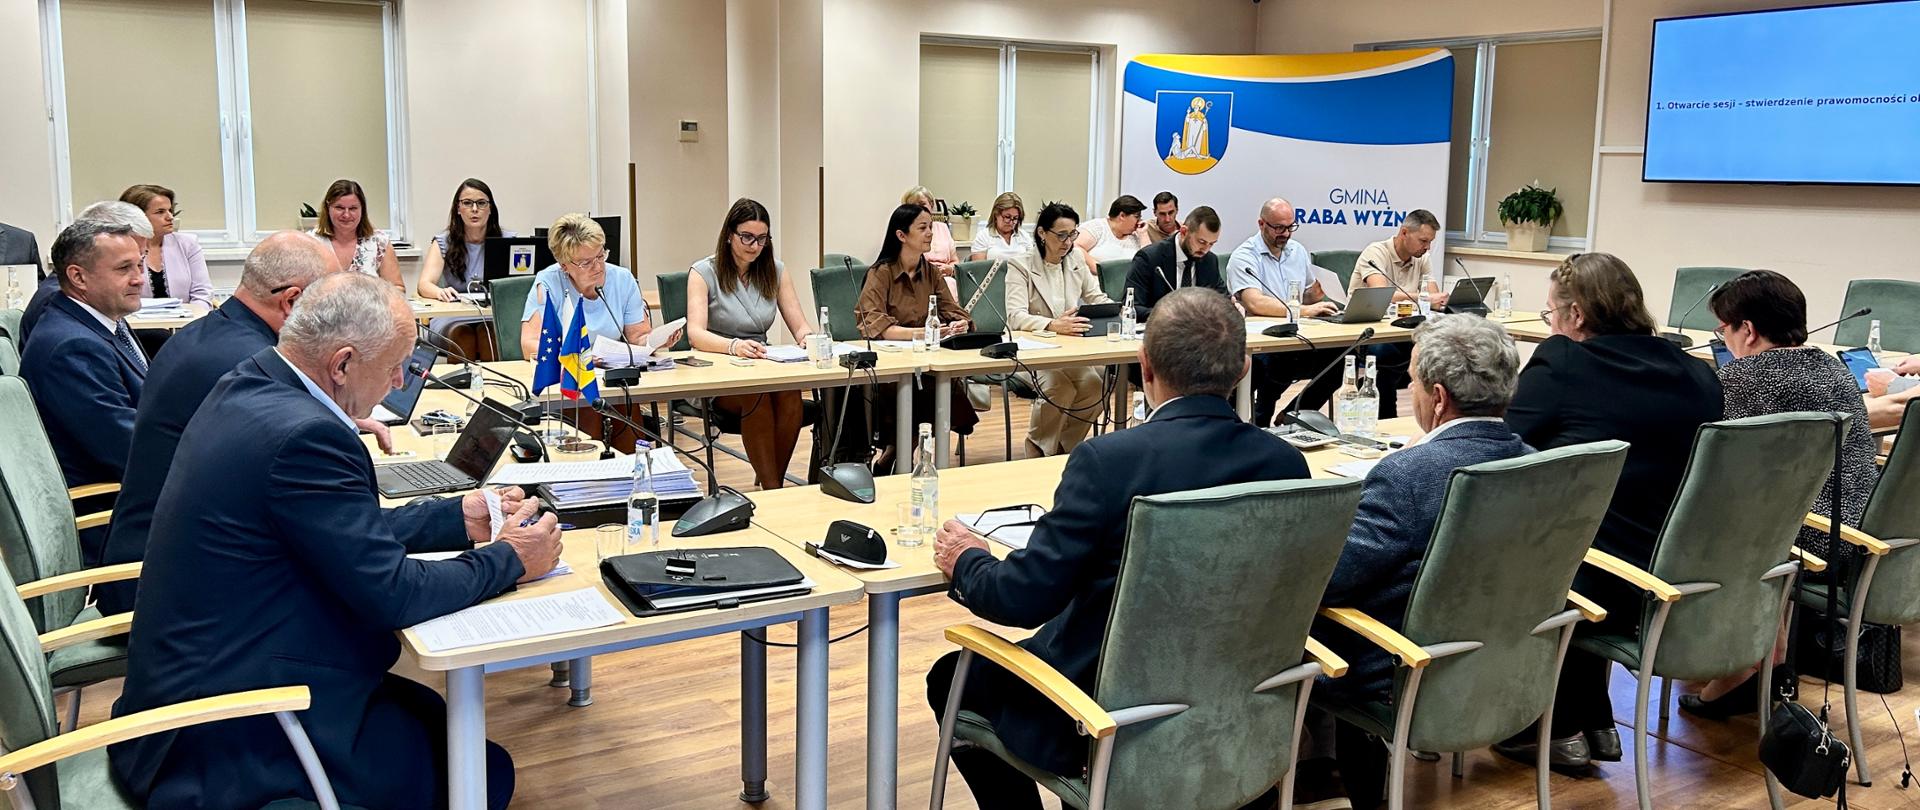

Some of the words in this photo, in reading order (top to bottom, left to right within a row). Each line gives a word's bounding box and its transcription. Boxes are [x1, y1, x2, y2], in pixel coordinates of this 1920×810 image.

[1656, 102, 1664, 110] 1.
[1667, 101, 1710, 110] Otwarcie
[1713, 100, 1735, 109] sesji
[1745, 98, 1813, 107] stwierdzenie
[1817, 94, 1906, 107] prawomocności
[1329, 188, 1389, 205] GMINA
[1295, 208, 1347, 225] RABA
[1354, 206, 1407, 227] WYŻN
